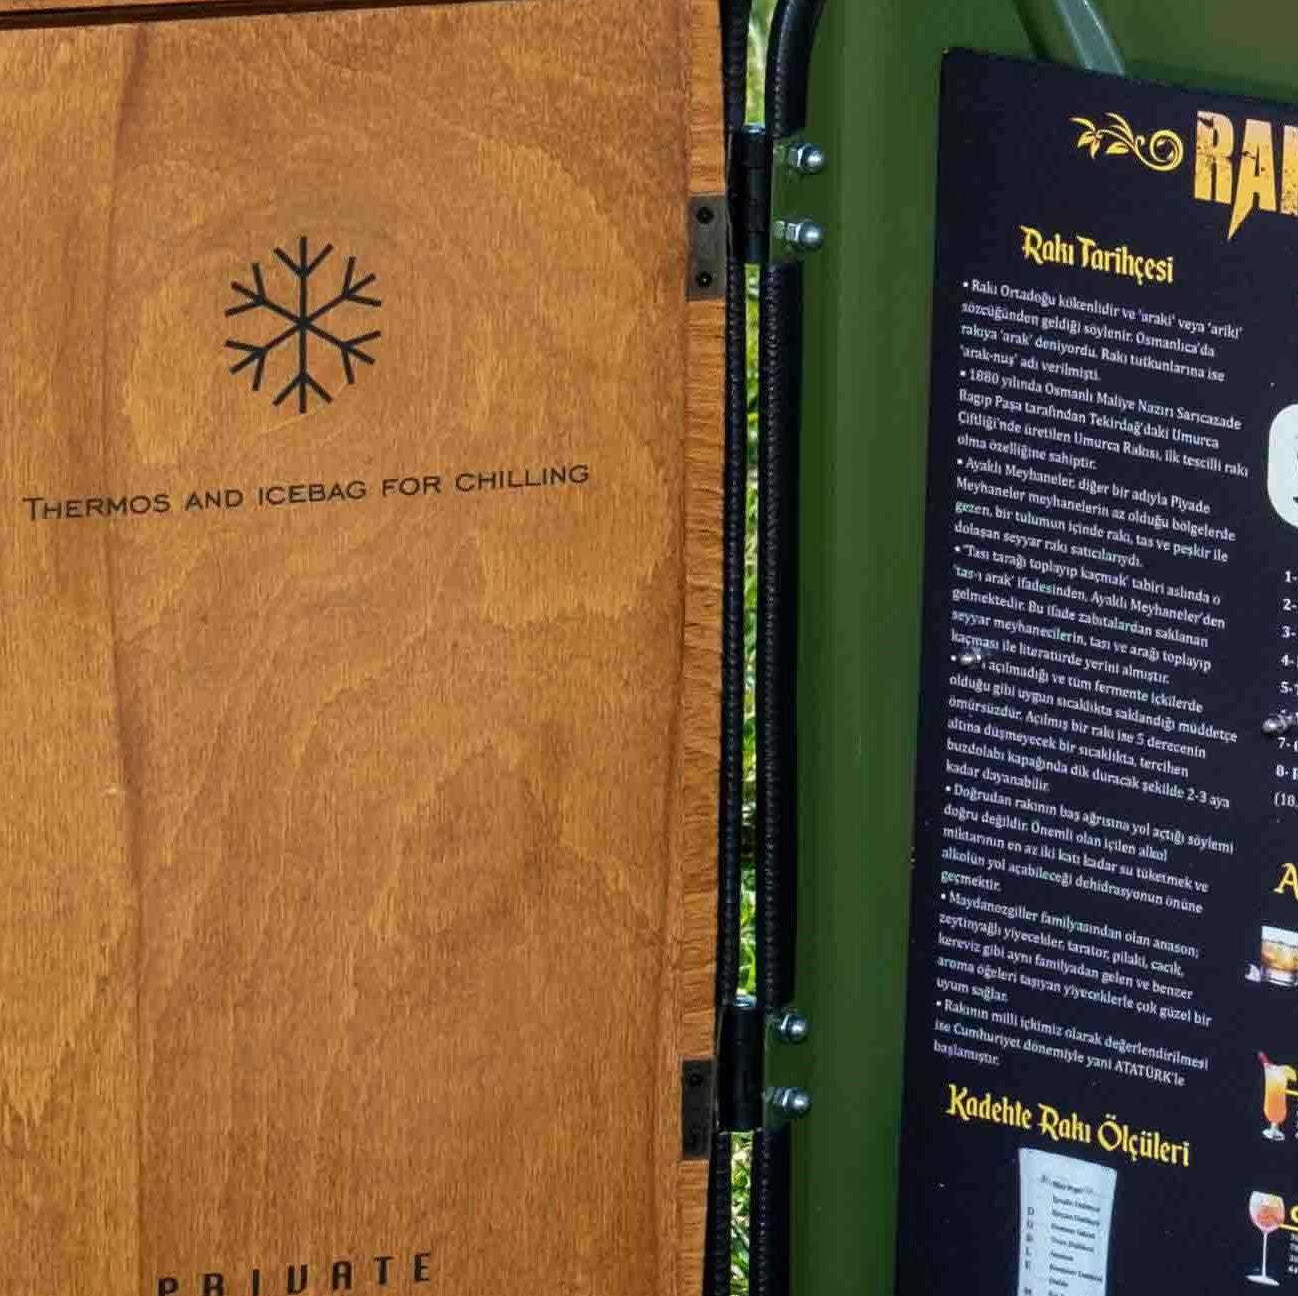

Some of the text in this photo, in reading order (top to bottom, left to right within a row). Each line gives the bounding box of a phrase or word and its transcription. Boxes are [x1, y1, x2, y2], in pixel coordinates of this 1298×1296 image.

[1020, 225, 1174, 286] Rakı Tarihçesi
[970, 278, 998, 296] Rakı
[1044, 381, 1095, 404] Osmanlı
[1073, 430, 1121, 454] Umurca
[1171, 426, 1220, 450] Umurca
[956, 475, 1027, 503] Meyhaneler
[1170, 494, 1211, 515] Piyade
[1012, 510, 1067, 533] tulumun
[1001, 531, 1044, 550] seyyar
[950, 609, 992, 627] seyyar
[1093, 679, 1149, 702] fermente
[945, 758, 981, 779] kadar
[945, 1083, 1190, 1168] Kadehte Rakı Ölçüleri
